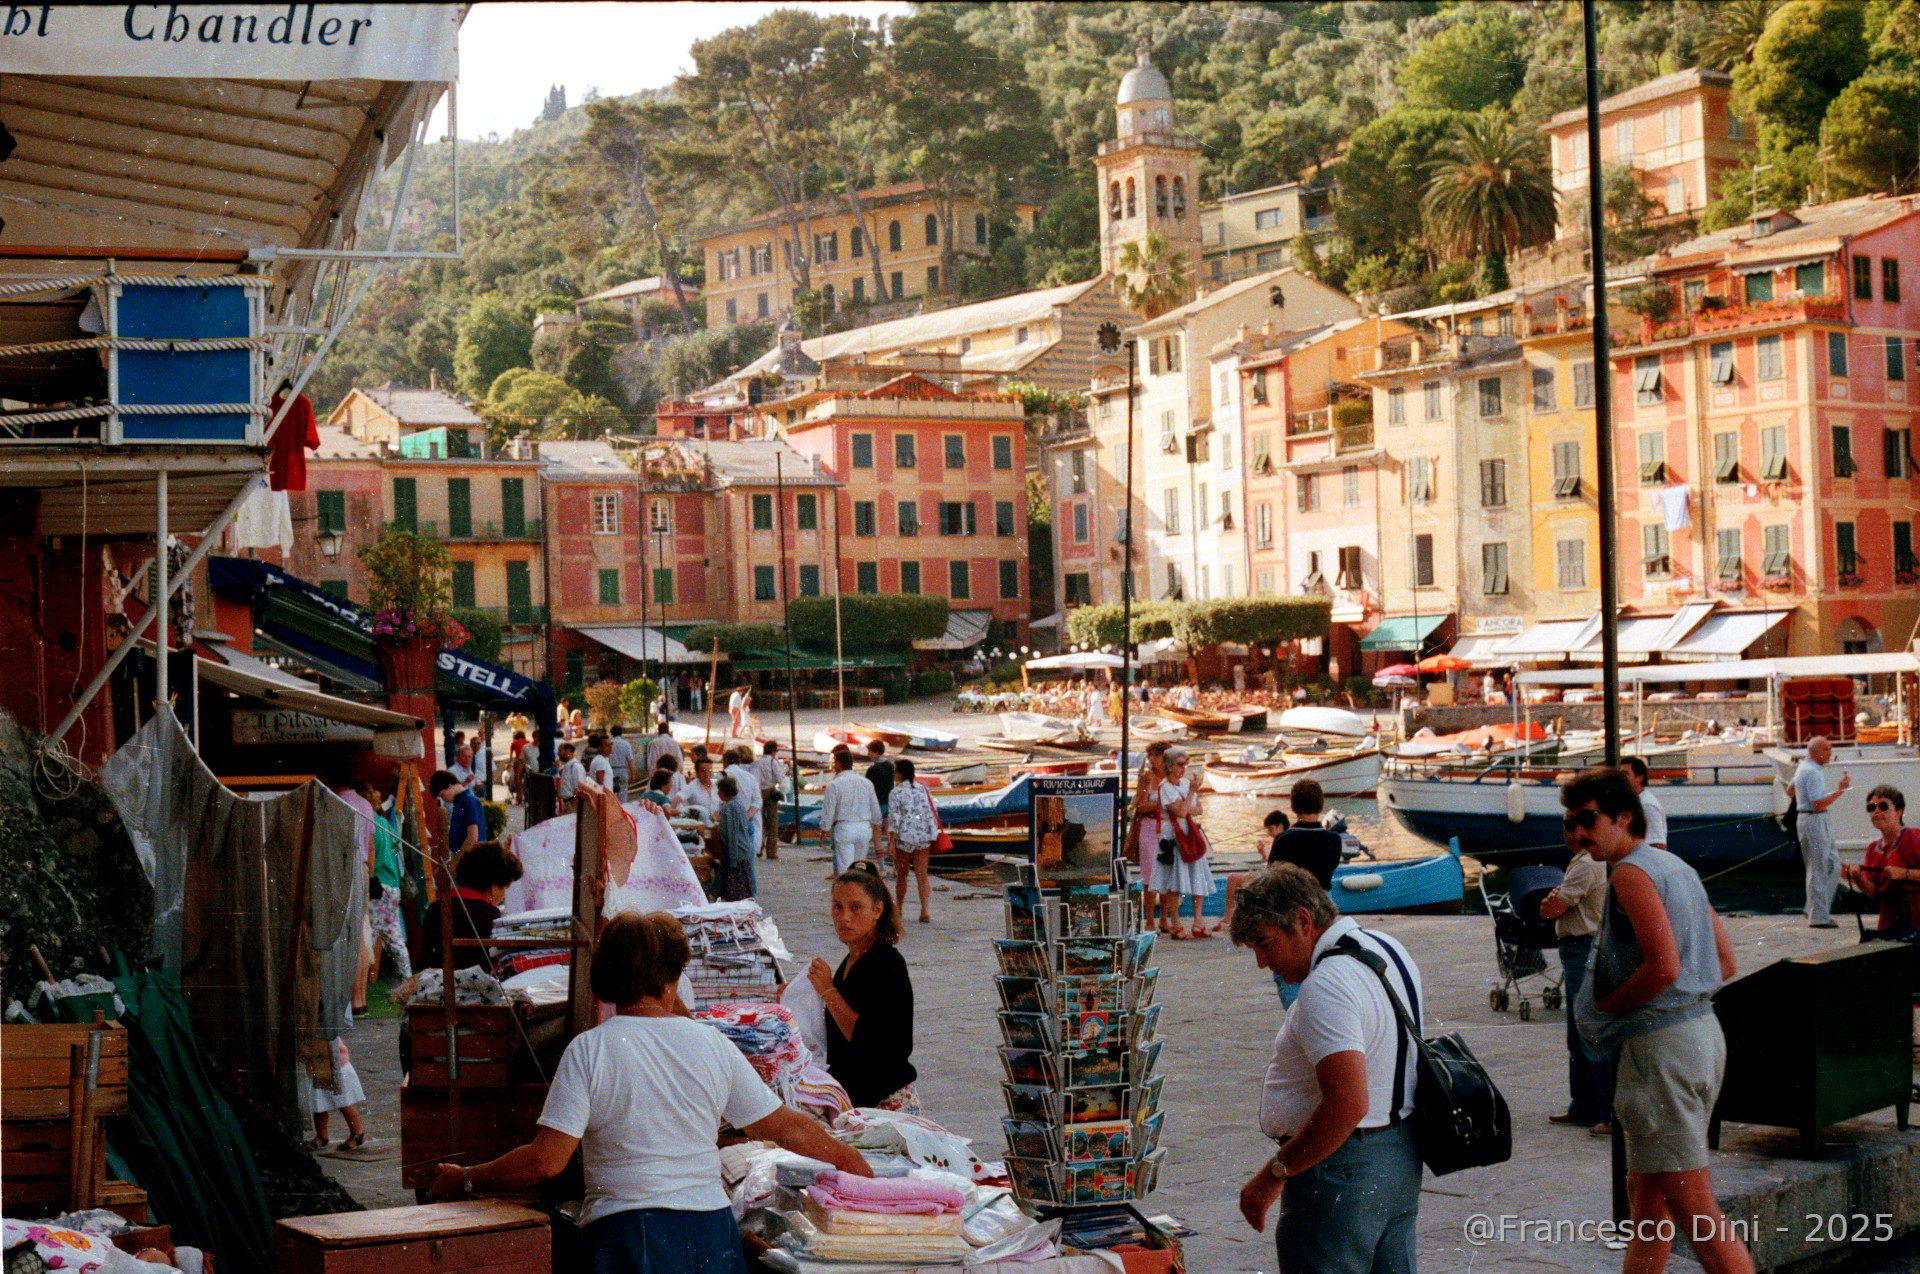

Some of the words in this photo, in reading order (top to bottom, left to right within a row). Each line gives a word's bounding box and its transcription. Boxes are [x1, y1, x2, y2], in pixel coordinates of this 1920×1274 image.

[124, 4, 373, 46] Chandler
[1043, 780, 1077, 789] RIVIERA
[1077, 778, 1107, 788] LIGURE
